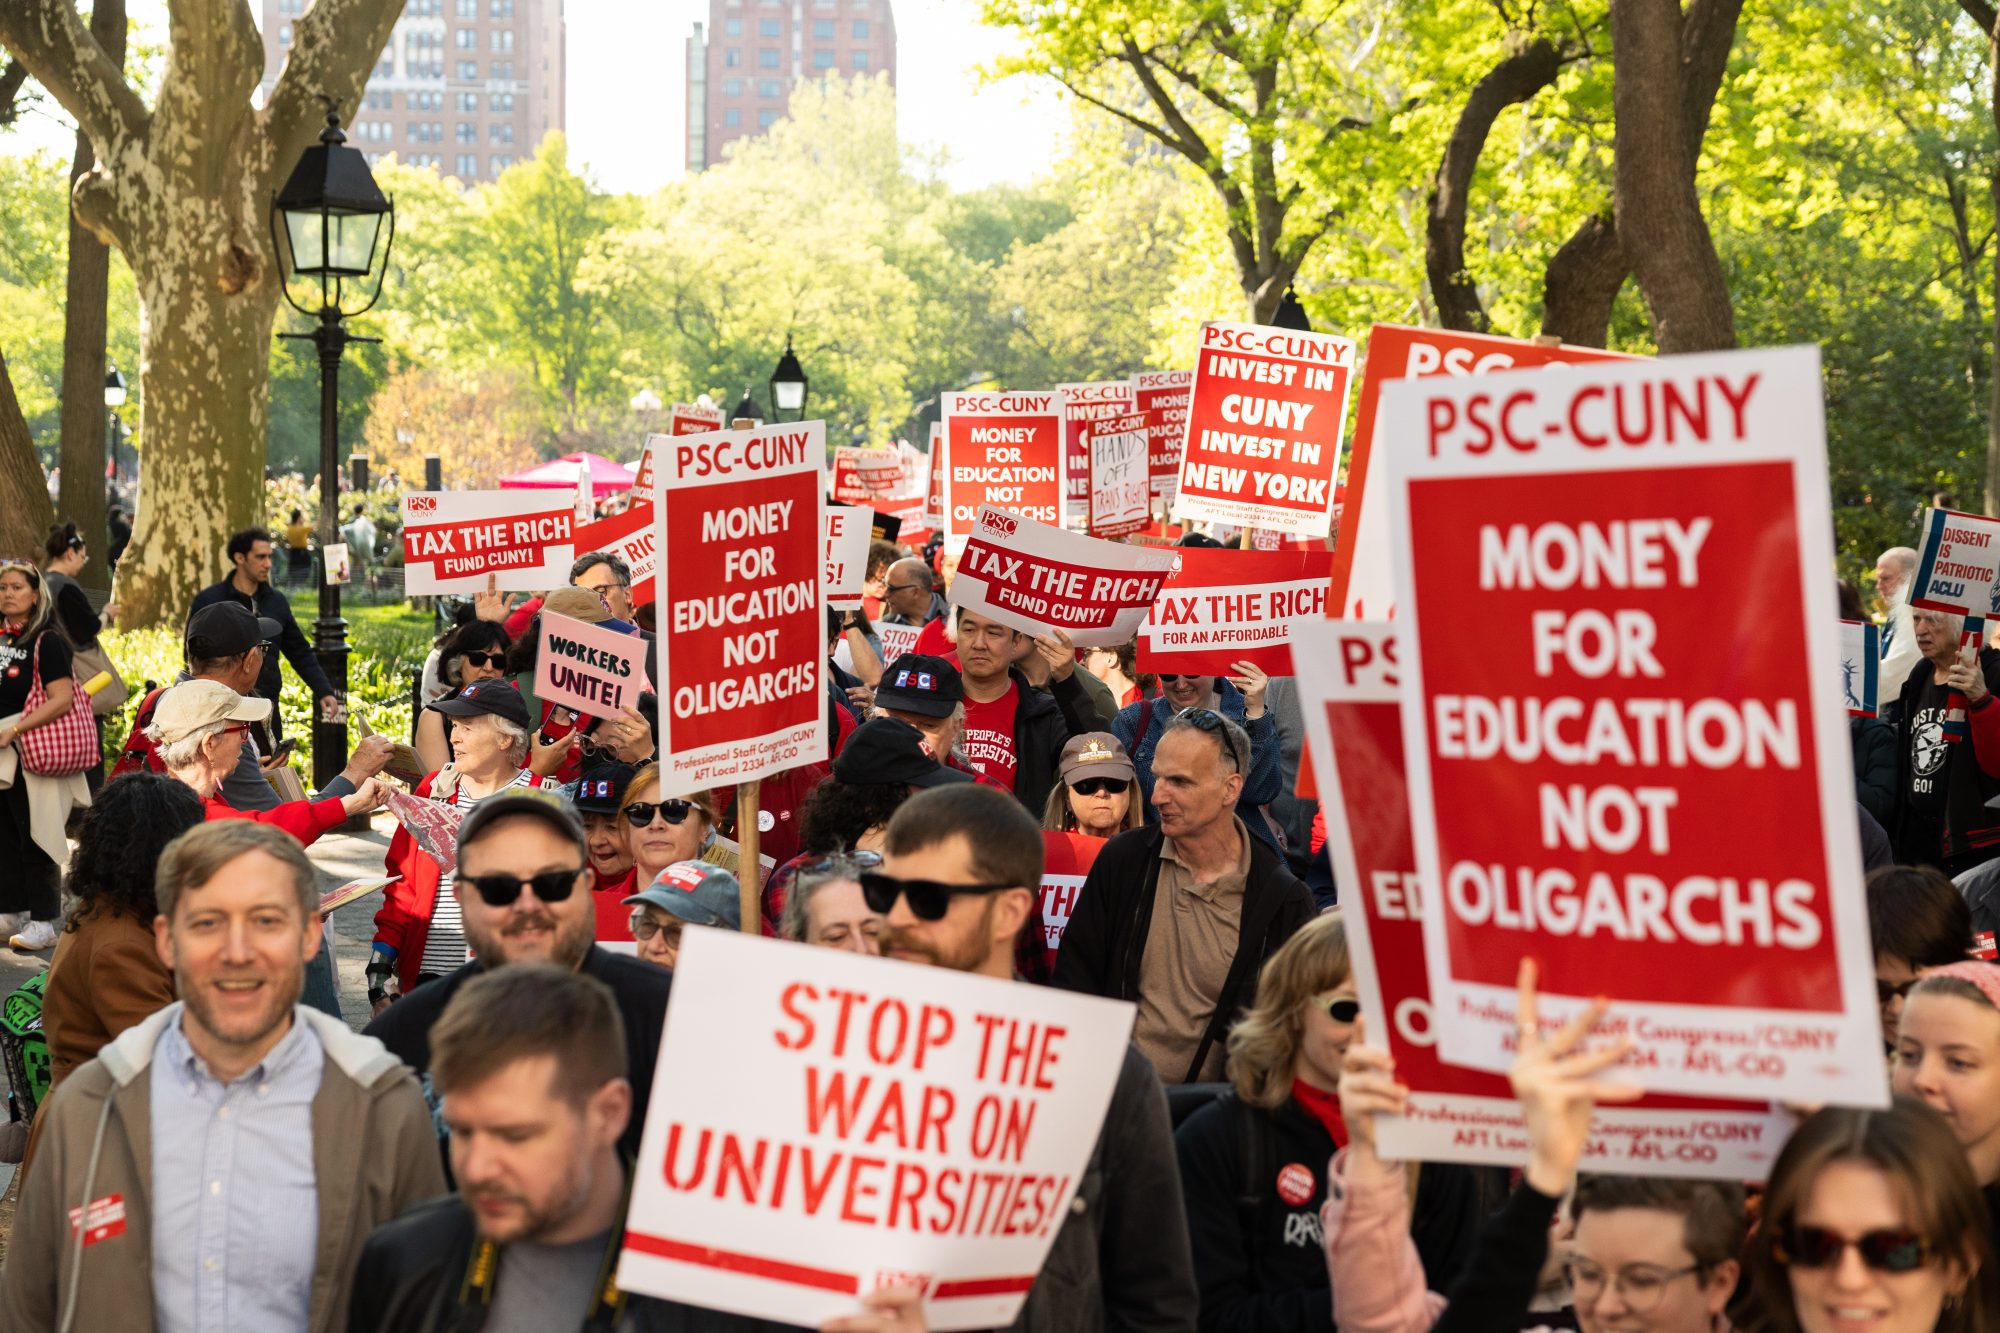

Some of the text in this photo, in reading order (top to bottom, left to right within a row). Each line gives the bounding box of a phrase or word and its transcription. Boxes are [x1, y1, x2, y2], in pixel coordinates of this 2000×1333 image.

[1204, 326, 1348, 362] PSC-CUNY
[1208, 355, 1334, 391] INVEST IN
[956, 397, 1051, 412] PSC-CUNY
[1066, 404, 1125, 421] INVEST
[1152, 395, 1188, 409] MONE
[1221, 393, 1314, 431] CUNY
[1427, 372, 1760, 458] PSC-CUNY
[1095, 416, 1145, 434] PSC-CUNY
[1163, 411, 1187, 422] FOR
[971, 427, 1037, 443] MONEY
[1164, 439, 1183, 450] NO
[1200, 430, 1285, 460] INVEST
[1292, 442, 1321, 465] IN
[677, 432, 809, 478] PSC-CUNY
[986, 447, 1023, 463] FOR
[1095, 432, 1146, 467] HANDS
[953, 467, 1055, 482] EDUCATION
[1103, 459, 1135, 486] OFF
[1183, 461, 1328, 505] NEW YORK
[985, 486, 1024, 502] NOT
[1067, 478, 1088, 495] NE
[1094, 487, 1120, 513] TRANS
[408, 496, 437, 510] PSC
[410, 510, 435, 518] CUNY
[1188, 498, 1233, 511] Professional
[1236, 504, 1252, 513] Staff
[1254, 507, 1292, 518] Congress
[1295, 512, 1317, 520] CUNY
[1222, 510, 1242, 519] Local
[1244, 513, 1260, 521] 2334
[701, 500, 794, 543] MONEY
[982, 511, 1018, 534] PSC
[982, 526, 1010, 541] CUNY
[406, 515, 571, 557] TAX THE RICH
[1943, 529, 1992, 549] DISSENT
[444, 548, 534, 574] FUND CUNY!
[725, 546, 777, 583] FOR
[1479, 517, 1713, 592] MONEY
[1939, 543, 1951, 559] IS
[967, 544, 1159, 602] TAX THE RICH
[1934, 560, 1994, 583] PATRIOTIC
[1928, 579, 1965, 598] ACLU
[674, 579, 815, 633] EDUCATION
[998, 588, 1106, 624] FUND CUNY!
[1149, 586, 1330, 625] TAX THE RICH
[883, 629, 917, 646] STOP
[1163, 624, 1289, 644] FOR AN AFFORDABLE
[1532, 608, 1665, 680] FOR
[548, 633, 631, 678] WORKERS
[723, 629, 779, 668] NOT
[550, 663, 622, 710] UNITE!
[674, 661, 815, 719] OLIGARCHS
[895, 671, 931, 689] PSC
[966, 729, 1012, 748] PEOPLE'S
[1433, 695, 1802, 770] EDUCATION
[674, 728, 816, 771] Professional Staff Congress/CUNY
[694, 768, 710, 781] AFT
[712, 764, 738, 777] Local
[742, 758, 765, 772] 2334
[770, 747, 798, 765] AFL-CIO
[581, 781, 608, 798] PSC
[1913, 778, 1933, 794] GO!
[1539, 783, 1677, 855] NOT
[1448, 860, 1822, 950] OLIGARCHS
[774, 981, 1069, 1092] STOP THE
[805, 1066, 1039, 1165] WAR ON
[662, 1122, 1071, 1240] UNIVERSITIES!
